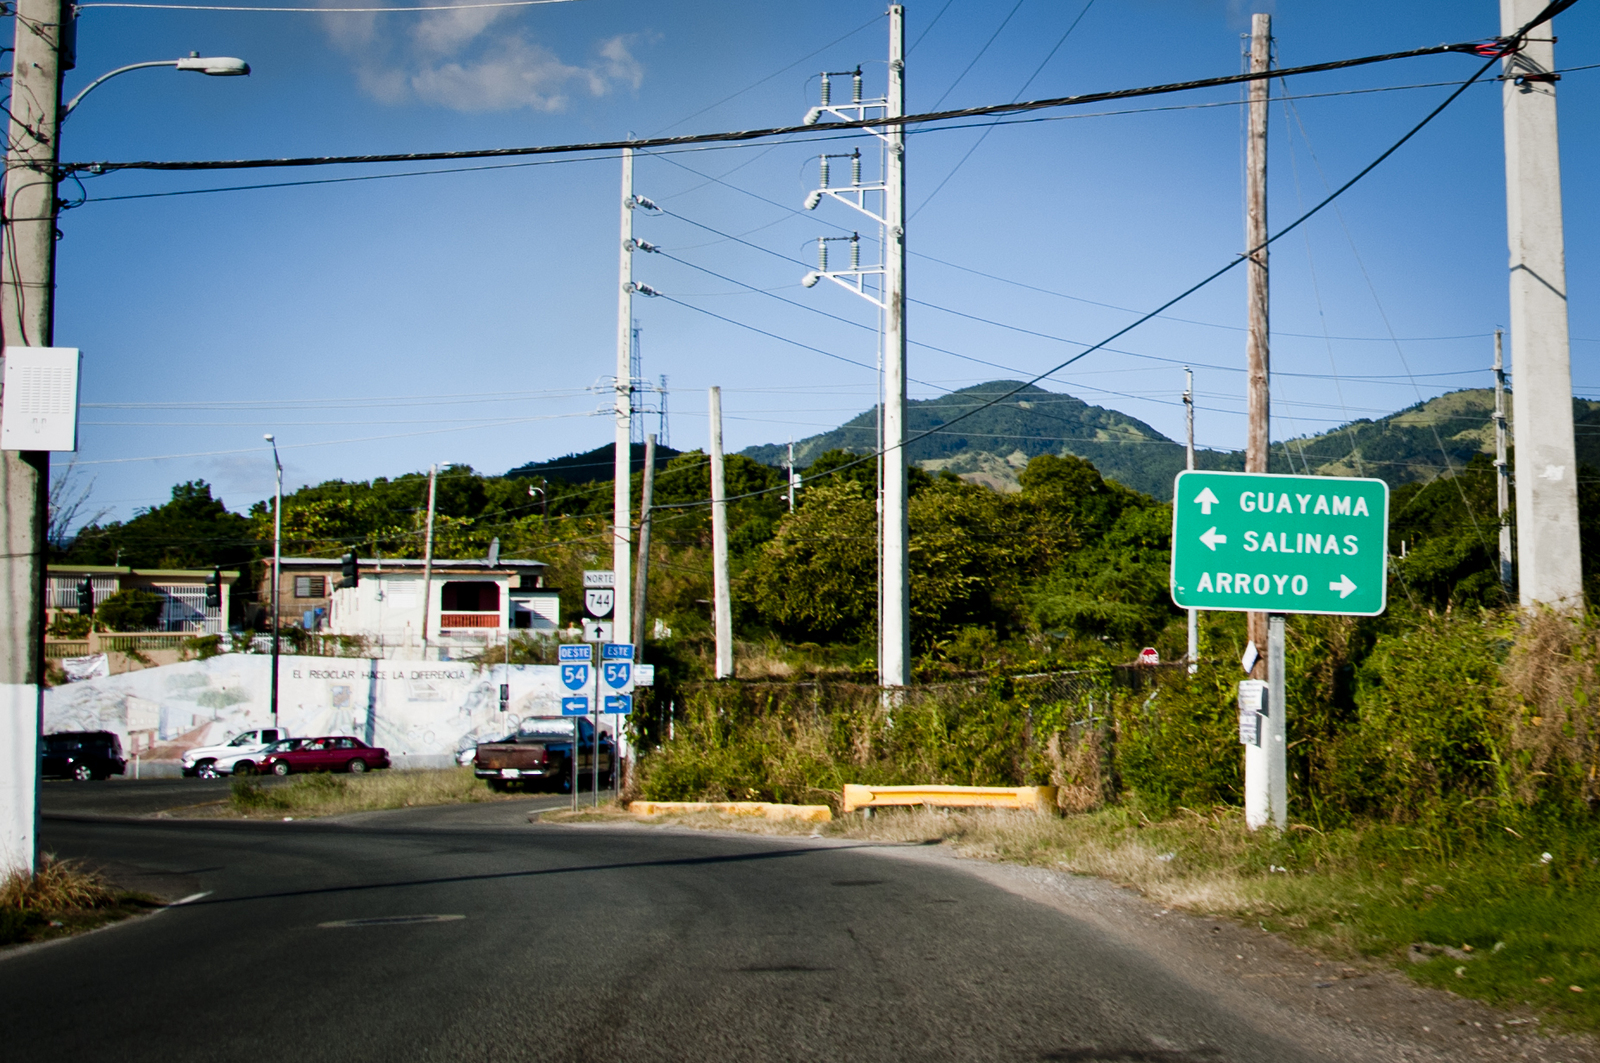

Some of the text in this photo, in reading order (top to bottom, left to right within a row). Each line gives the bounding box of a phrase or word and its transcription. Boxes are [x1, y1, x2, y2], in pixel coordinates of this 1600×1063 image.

[1239, 491, 1370, 517] GUAYAMA
[1243, 530, 1359, 556] SALINAS
[586, 574, 614, 584] NORTE
[1196, 571, 1309, 596] ARROYO
[589, 593, 610, 608] 744
[561, 647, 590, 658] OESTE
[607, 646, 629, 657] ESTE
[292, 669, 466, 681] EL RECICLAR HACE LA DIFERENCIA
[564, 666, 586, 684] 54
[607, 665, 628, 682] 54
